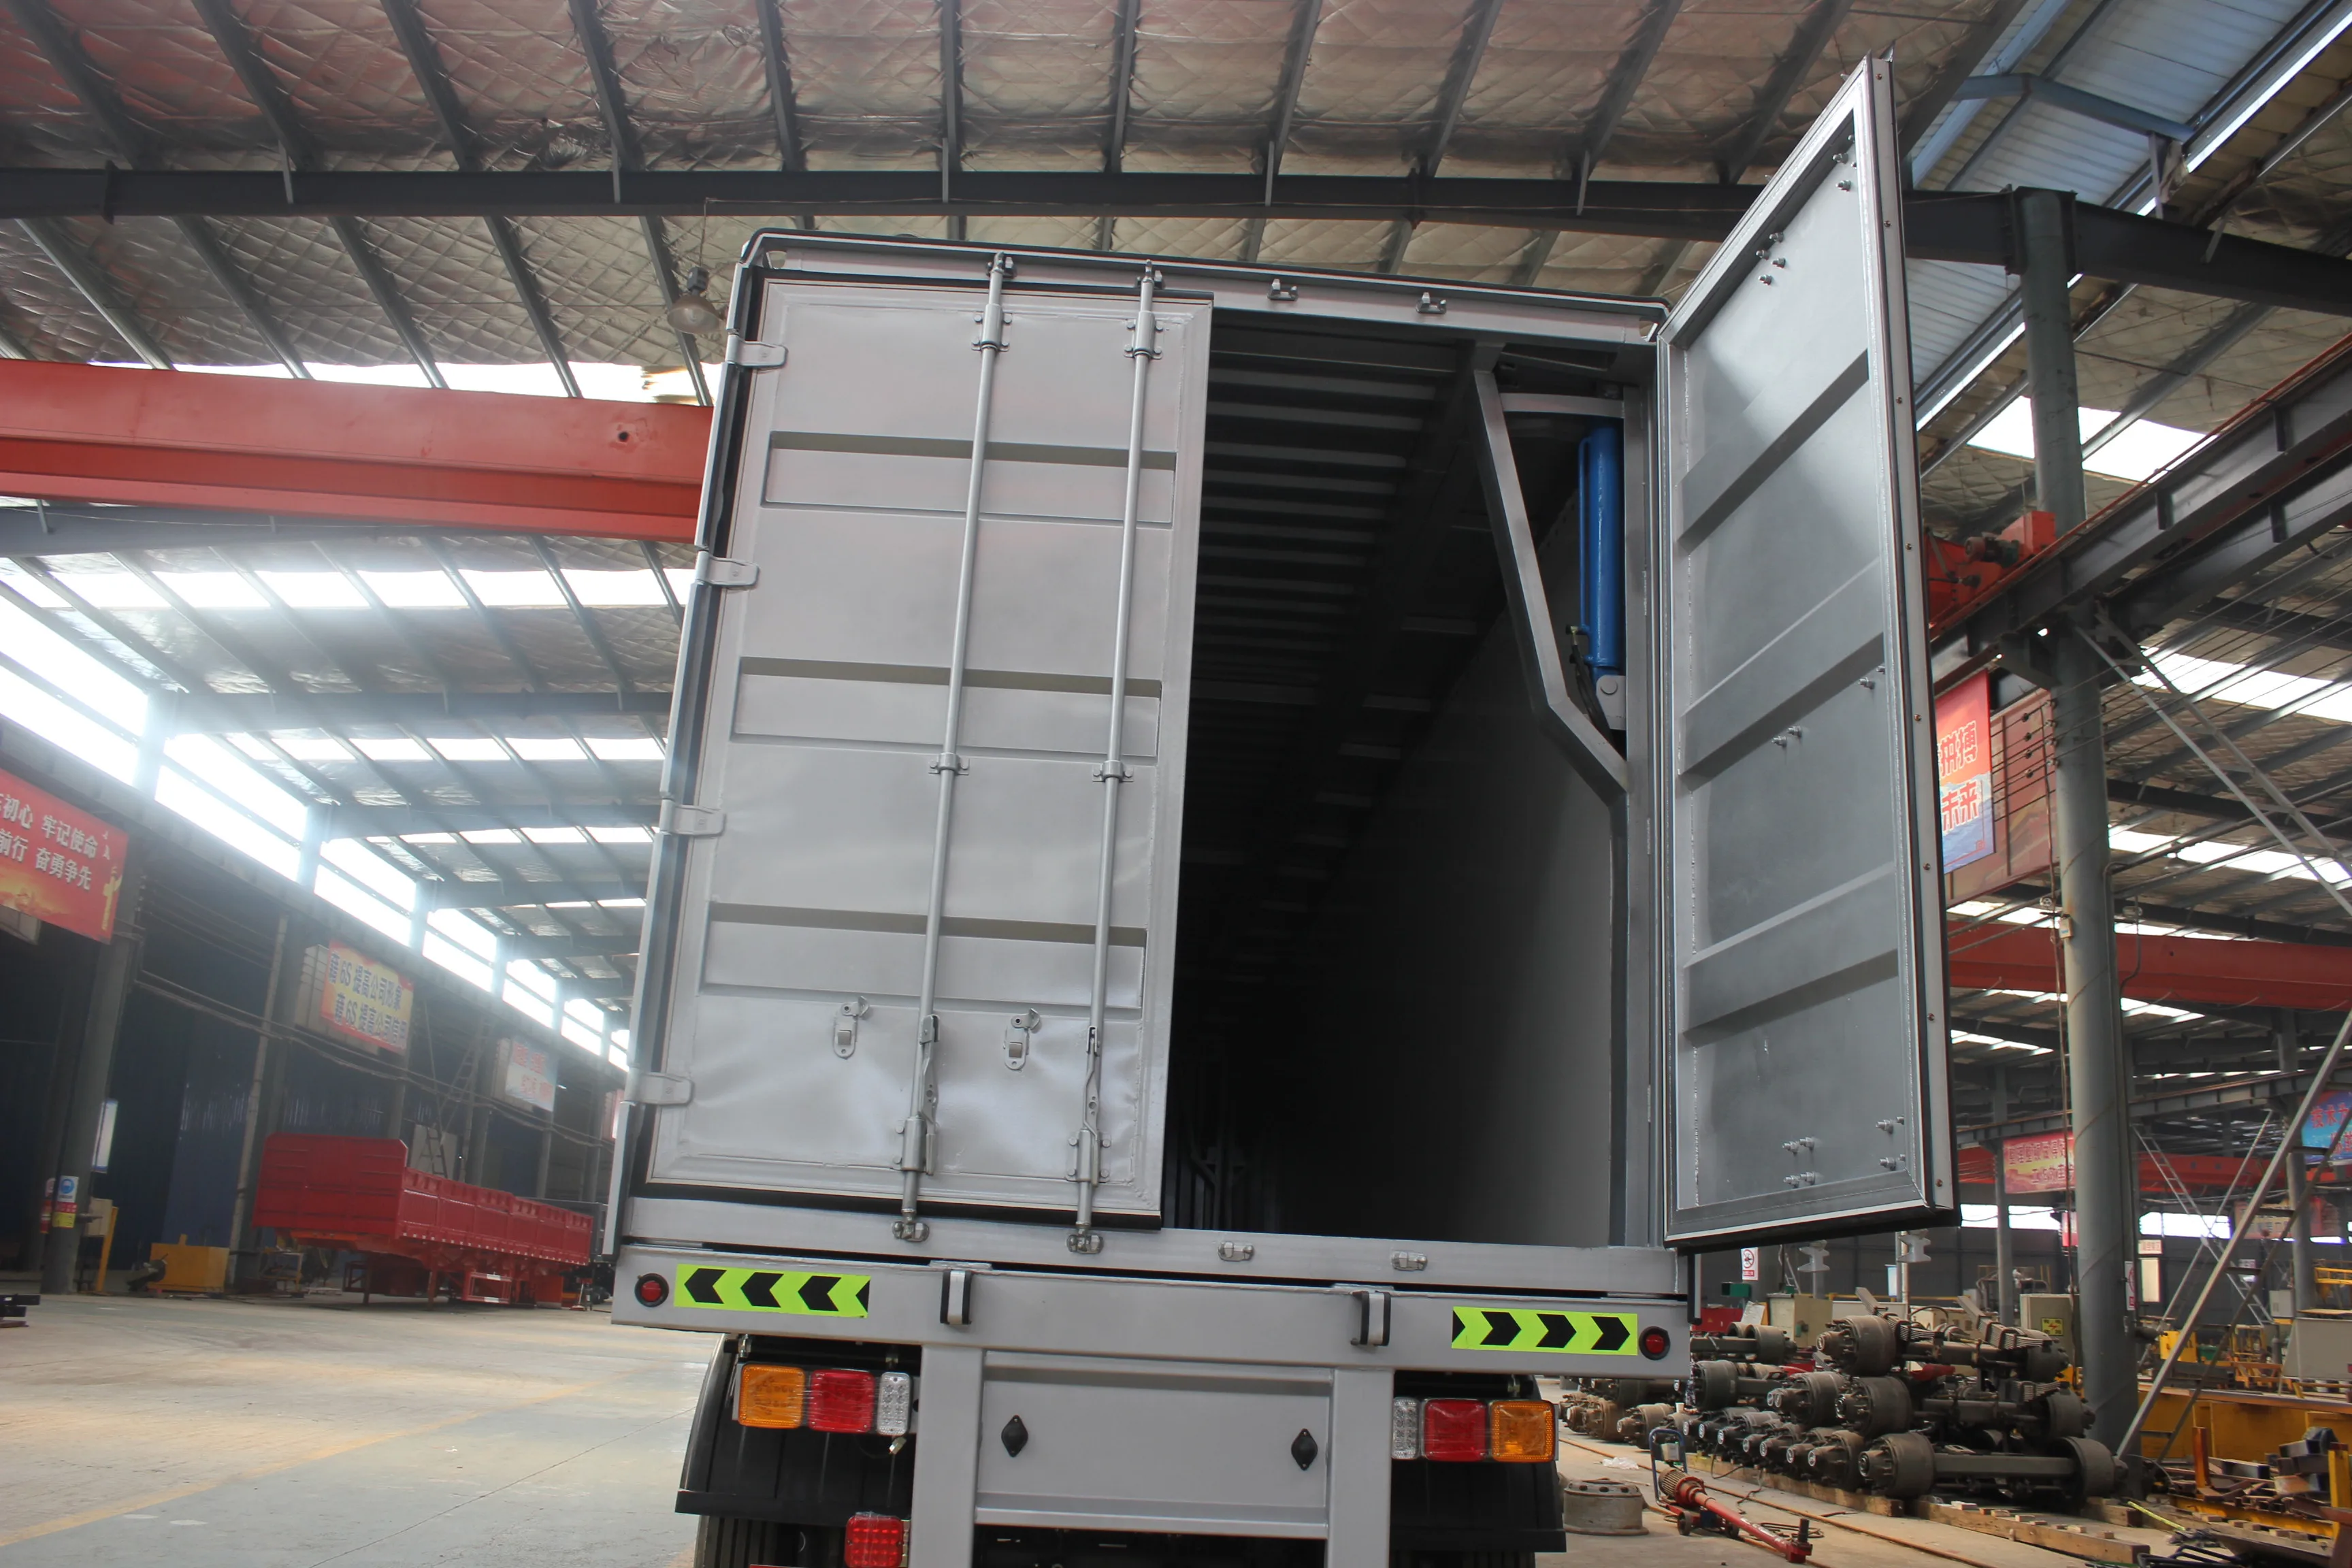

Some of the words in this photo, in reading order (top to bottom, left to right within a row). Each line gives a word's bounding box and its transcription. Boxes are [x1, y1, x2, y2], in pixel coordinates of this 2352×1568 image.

[1942, 780, 1979, 834] 未来
[42, 814, 99, 859] 牢记使命
[35, 847, 93, 890] 奋勇争先
